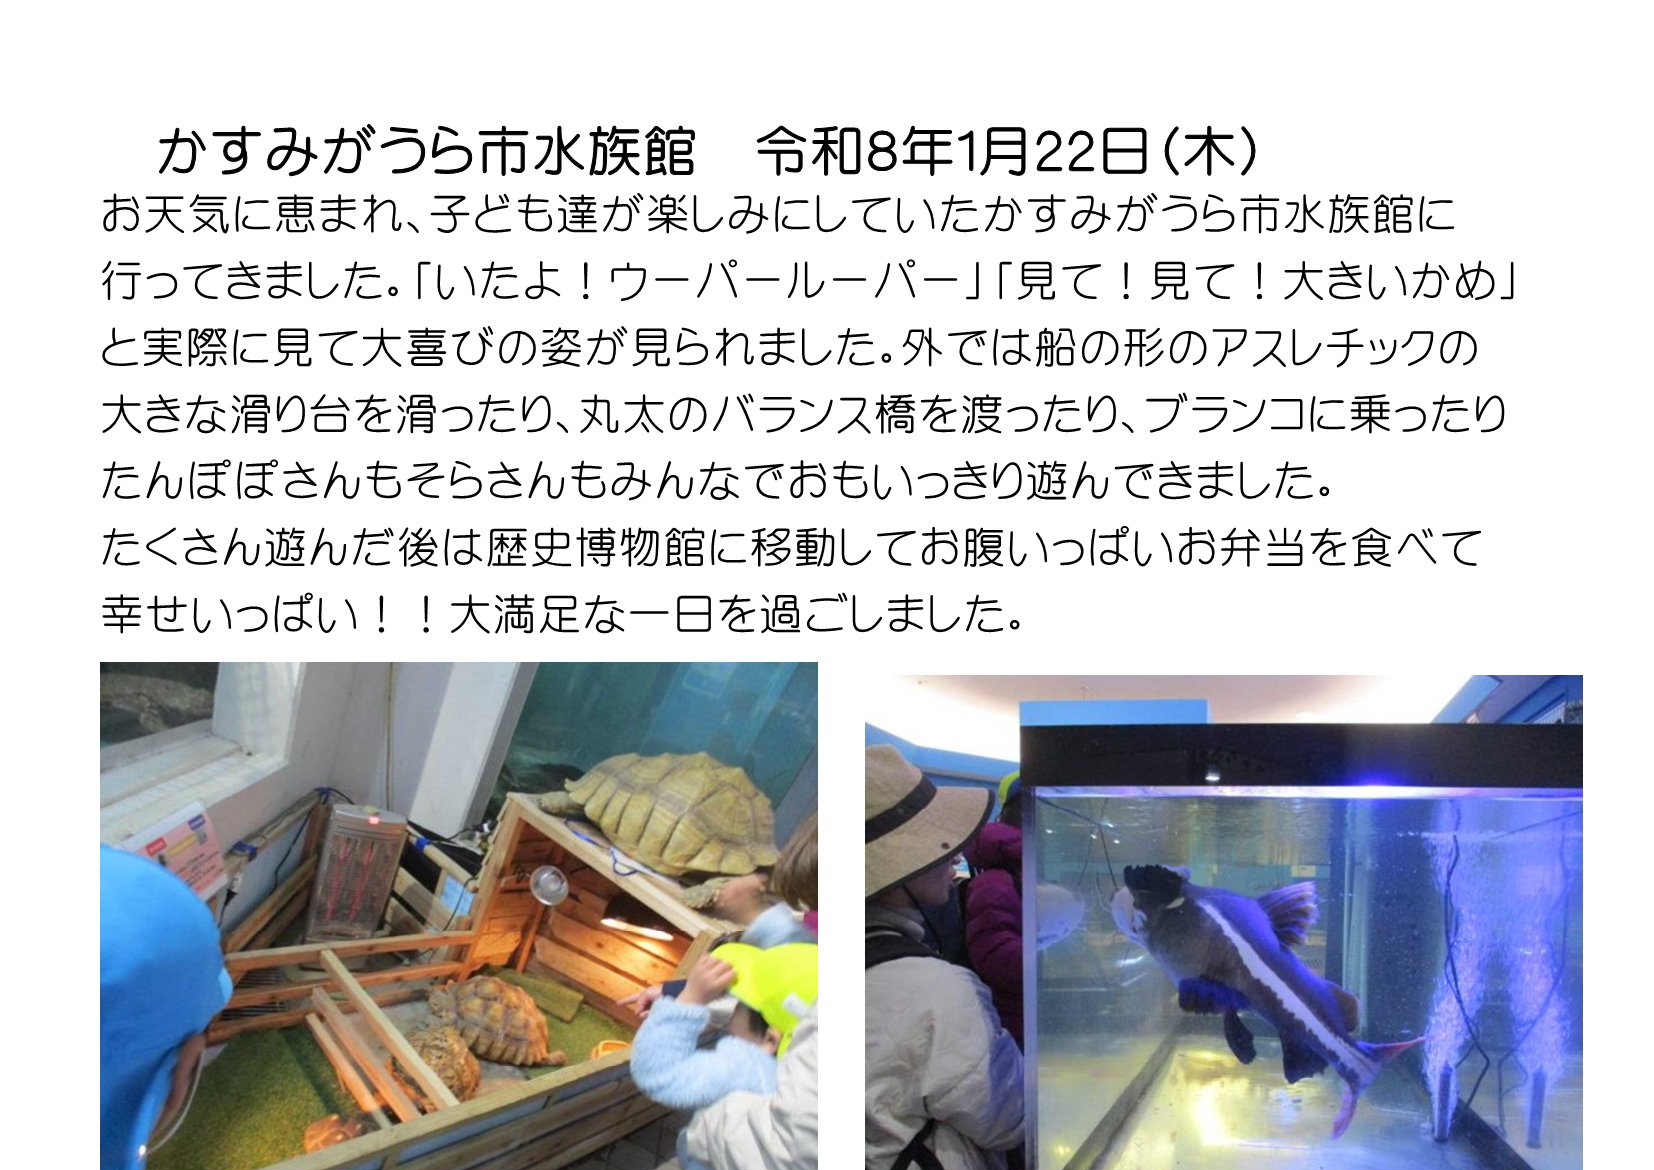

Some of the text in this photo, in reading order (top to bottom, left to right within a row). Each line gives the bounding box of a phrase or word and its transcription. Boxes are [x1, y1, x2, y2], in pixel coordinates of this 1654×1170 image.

[159, 124, 1256, 176] かすみがうら市水族館 令和8年1月22日（木）
[103, 193, 1454, 234] お天気に恵まれ、子ども達が楽しみにしていたかすみがうら市水族館に
[102, 259, 1514, 301] 行ってきました。「いたよ！ウーパールーパー」「見て！見て！大きいかめ」
[102, 326, 1477, 368] と実際に見て大喜びの姿が見られました。外では船の形のアスレチックの
[102, 393, 1506, 434] 大きな滑り台を滑ったり、丸太のバランス橋を渡ったり、ブランコに乗ったり
[103, 459, 1330, 500] たんぽぽさんもそらさんもみんなでおもいっきり遊んできました。
[103, 526, 1481, 567] たくさん遊んだ後は歴史博物館に移動してお腹いっぱいお弁当を食べて
[102, 593, 1021, 634] 幸せいっぱい！！大満足な一日を過ごしました。
